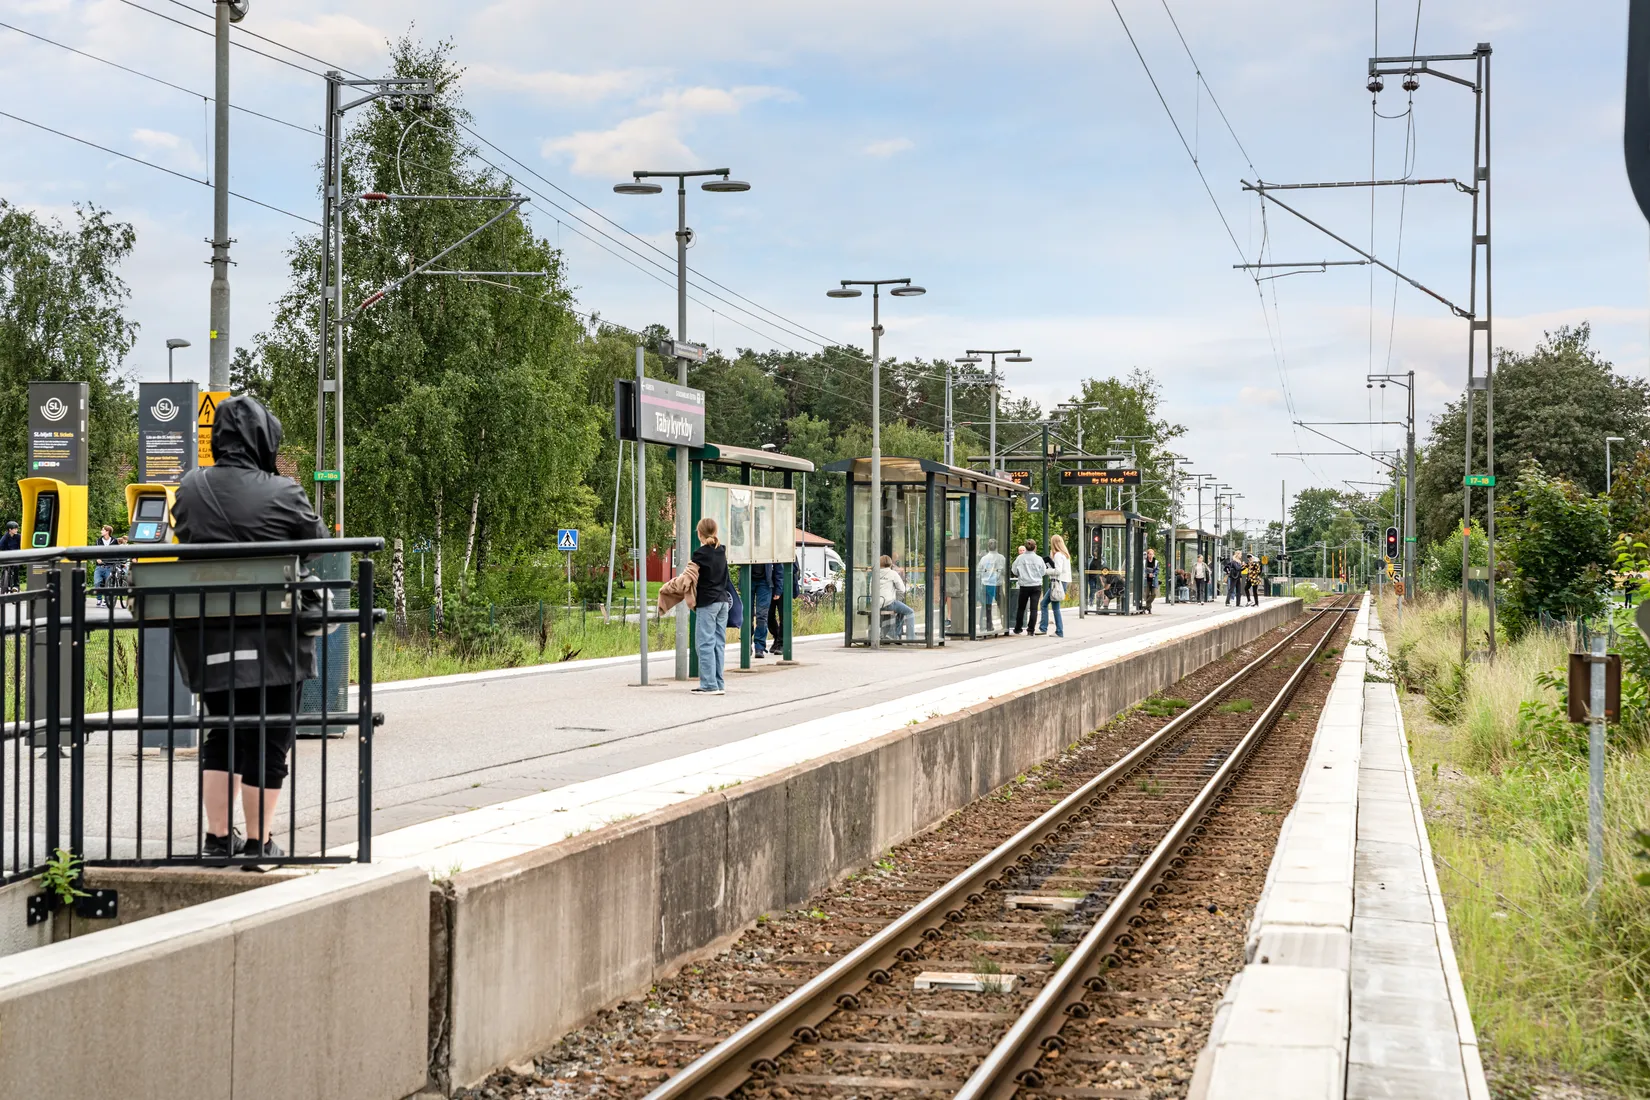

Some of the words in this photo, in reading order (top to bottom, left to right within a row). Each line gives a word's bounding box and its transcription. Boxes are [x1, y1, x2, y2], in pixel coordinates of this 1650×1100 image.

[49, 402, 59, 410] SL
[160, 403, 170, 411] SL
[656, 411, 671, 438] Täby
[671, 414, 693, 442] kyrkby
[1030, 497, 1039, 510] 2
[1475, 569, 1481, 577] 7
